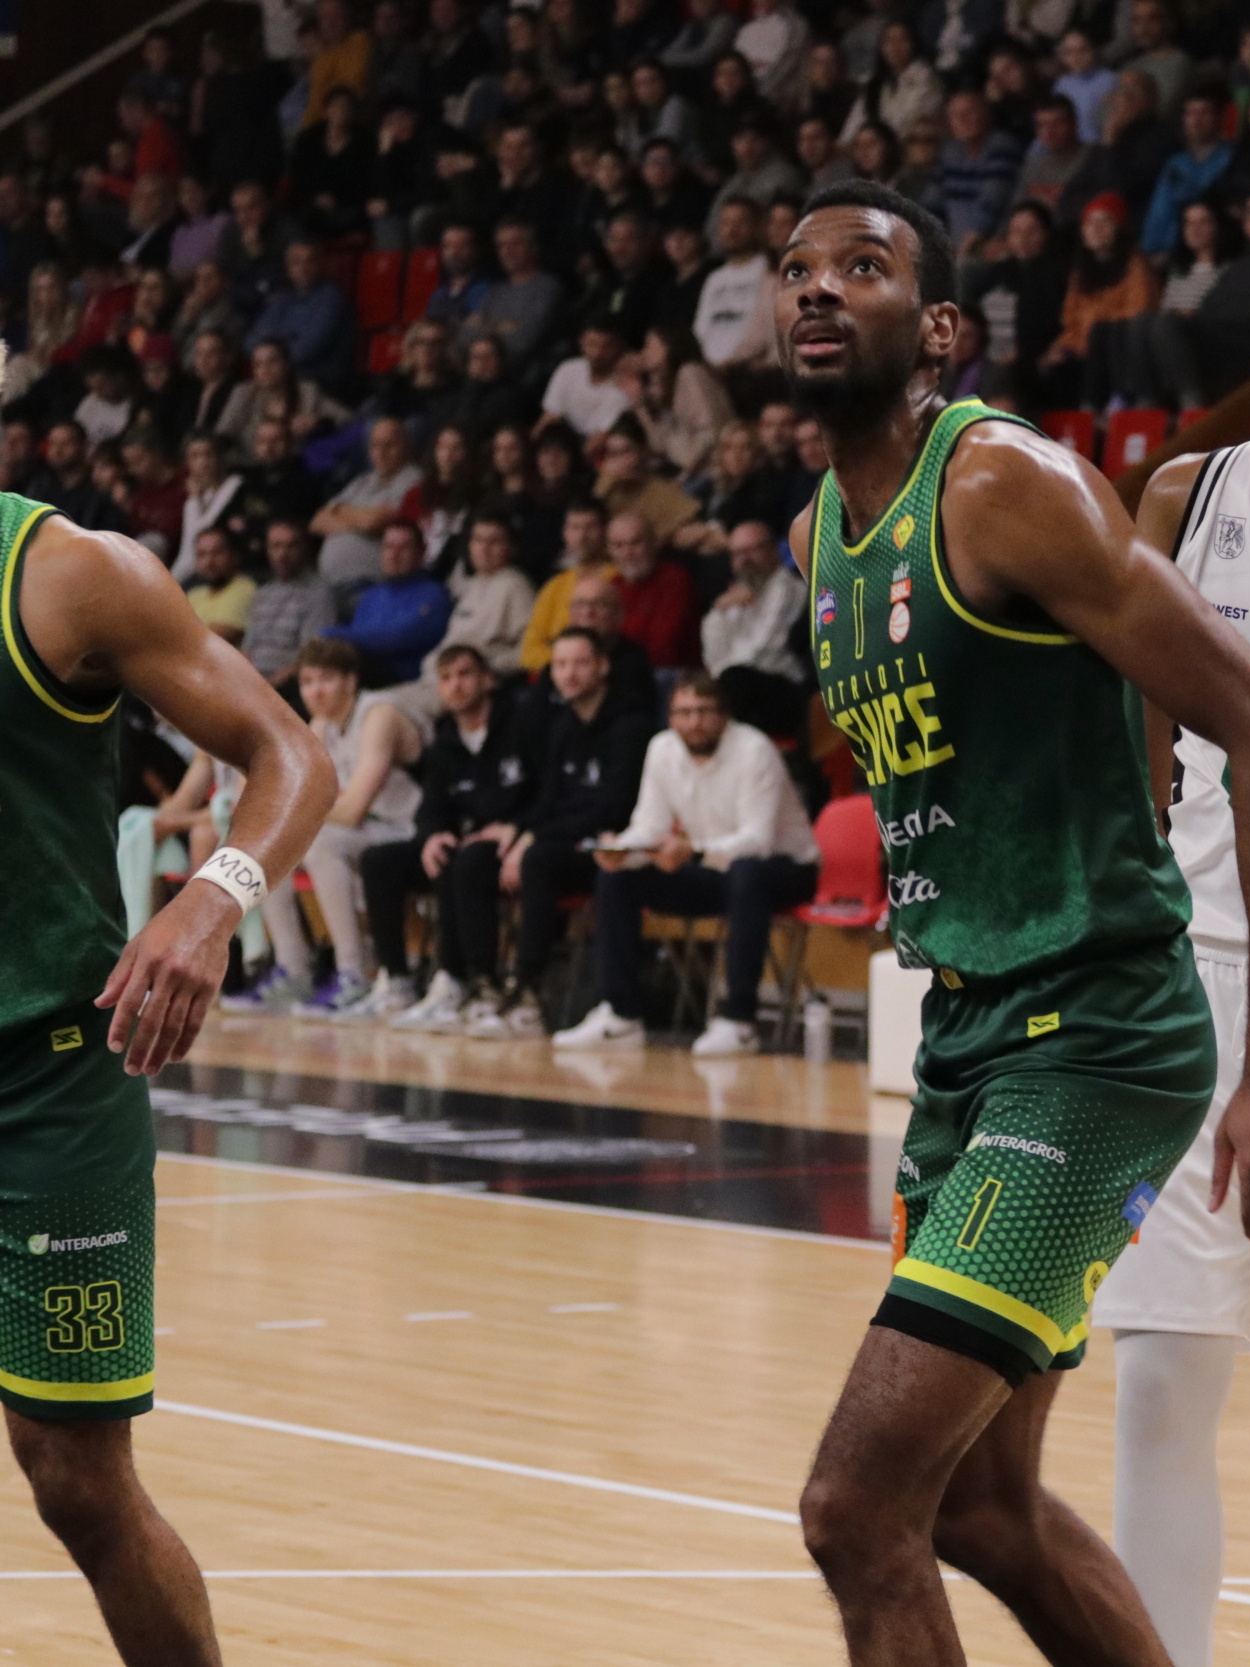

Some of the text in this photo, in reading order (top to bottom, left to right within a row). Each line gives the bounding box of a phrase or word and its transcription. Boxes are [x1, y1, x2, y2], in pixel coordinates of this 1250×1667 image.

[821, 652, 927, 711] ATRIOTI
[980, 1135, 1067, 1164] INTERAGROS
[51, 1230, 128, 1252] INTERAGROS
[957, 1178, 1002, 1250] 1
[45, 1280, 124, 1353] 33
